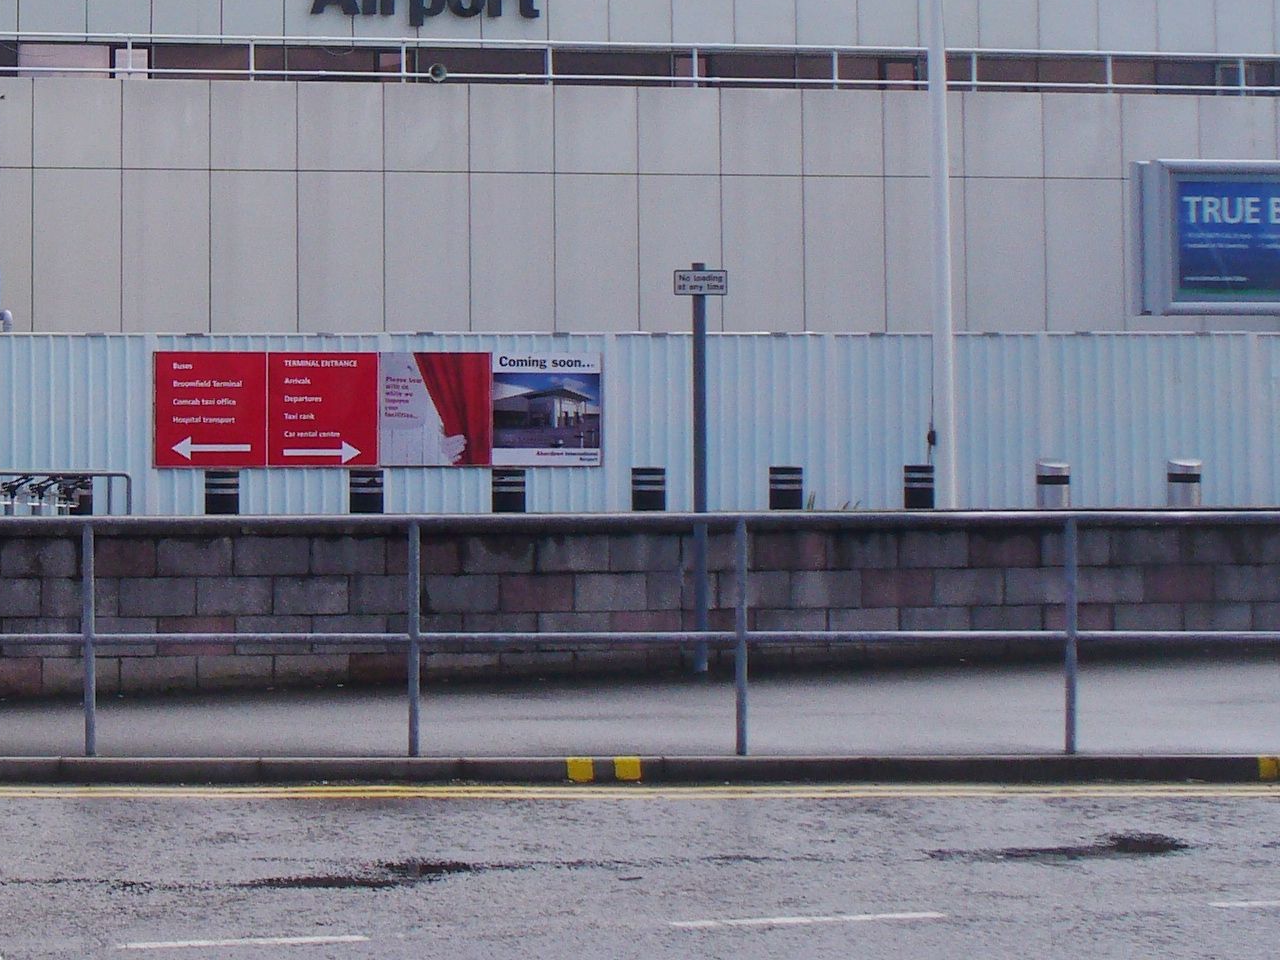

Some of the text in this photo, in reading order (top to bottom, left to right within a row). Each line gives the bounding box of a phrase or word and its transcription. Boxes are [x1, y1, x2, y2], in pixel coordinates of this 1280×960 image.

[1182, 195, 1261, 224] TRUE
[693, 274, 723, 283] loading
[173, 362, 193, 370] Buses
[284, 359, 357, 368] TERMINAL ENTRANCE
[499, 355, 595, 370] Coming soon...
[173, 379, 243, 387] Broomfield Terminal
[284, 377, 311, 385] Arrivals
[201, 398, 215, 406] taxi
[216, 398, 237, 406] office
[284, 395, 322, 404] Departures
[173, 416, 201, 424] Hospital
[284, 412, 315, 420] Taxi rank
[284, 430, 296, 438] Car
[297, 430, 318, 438] rental
